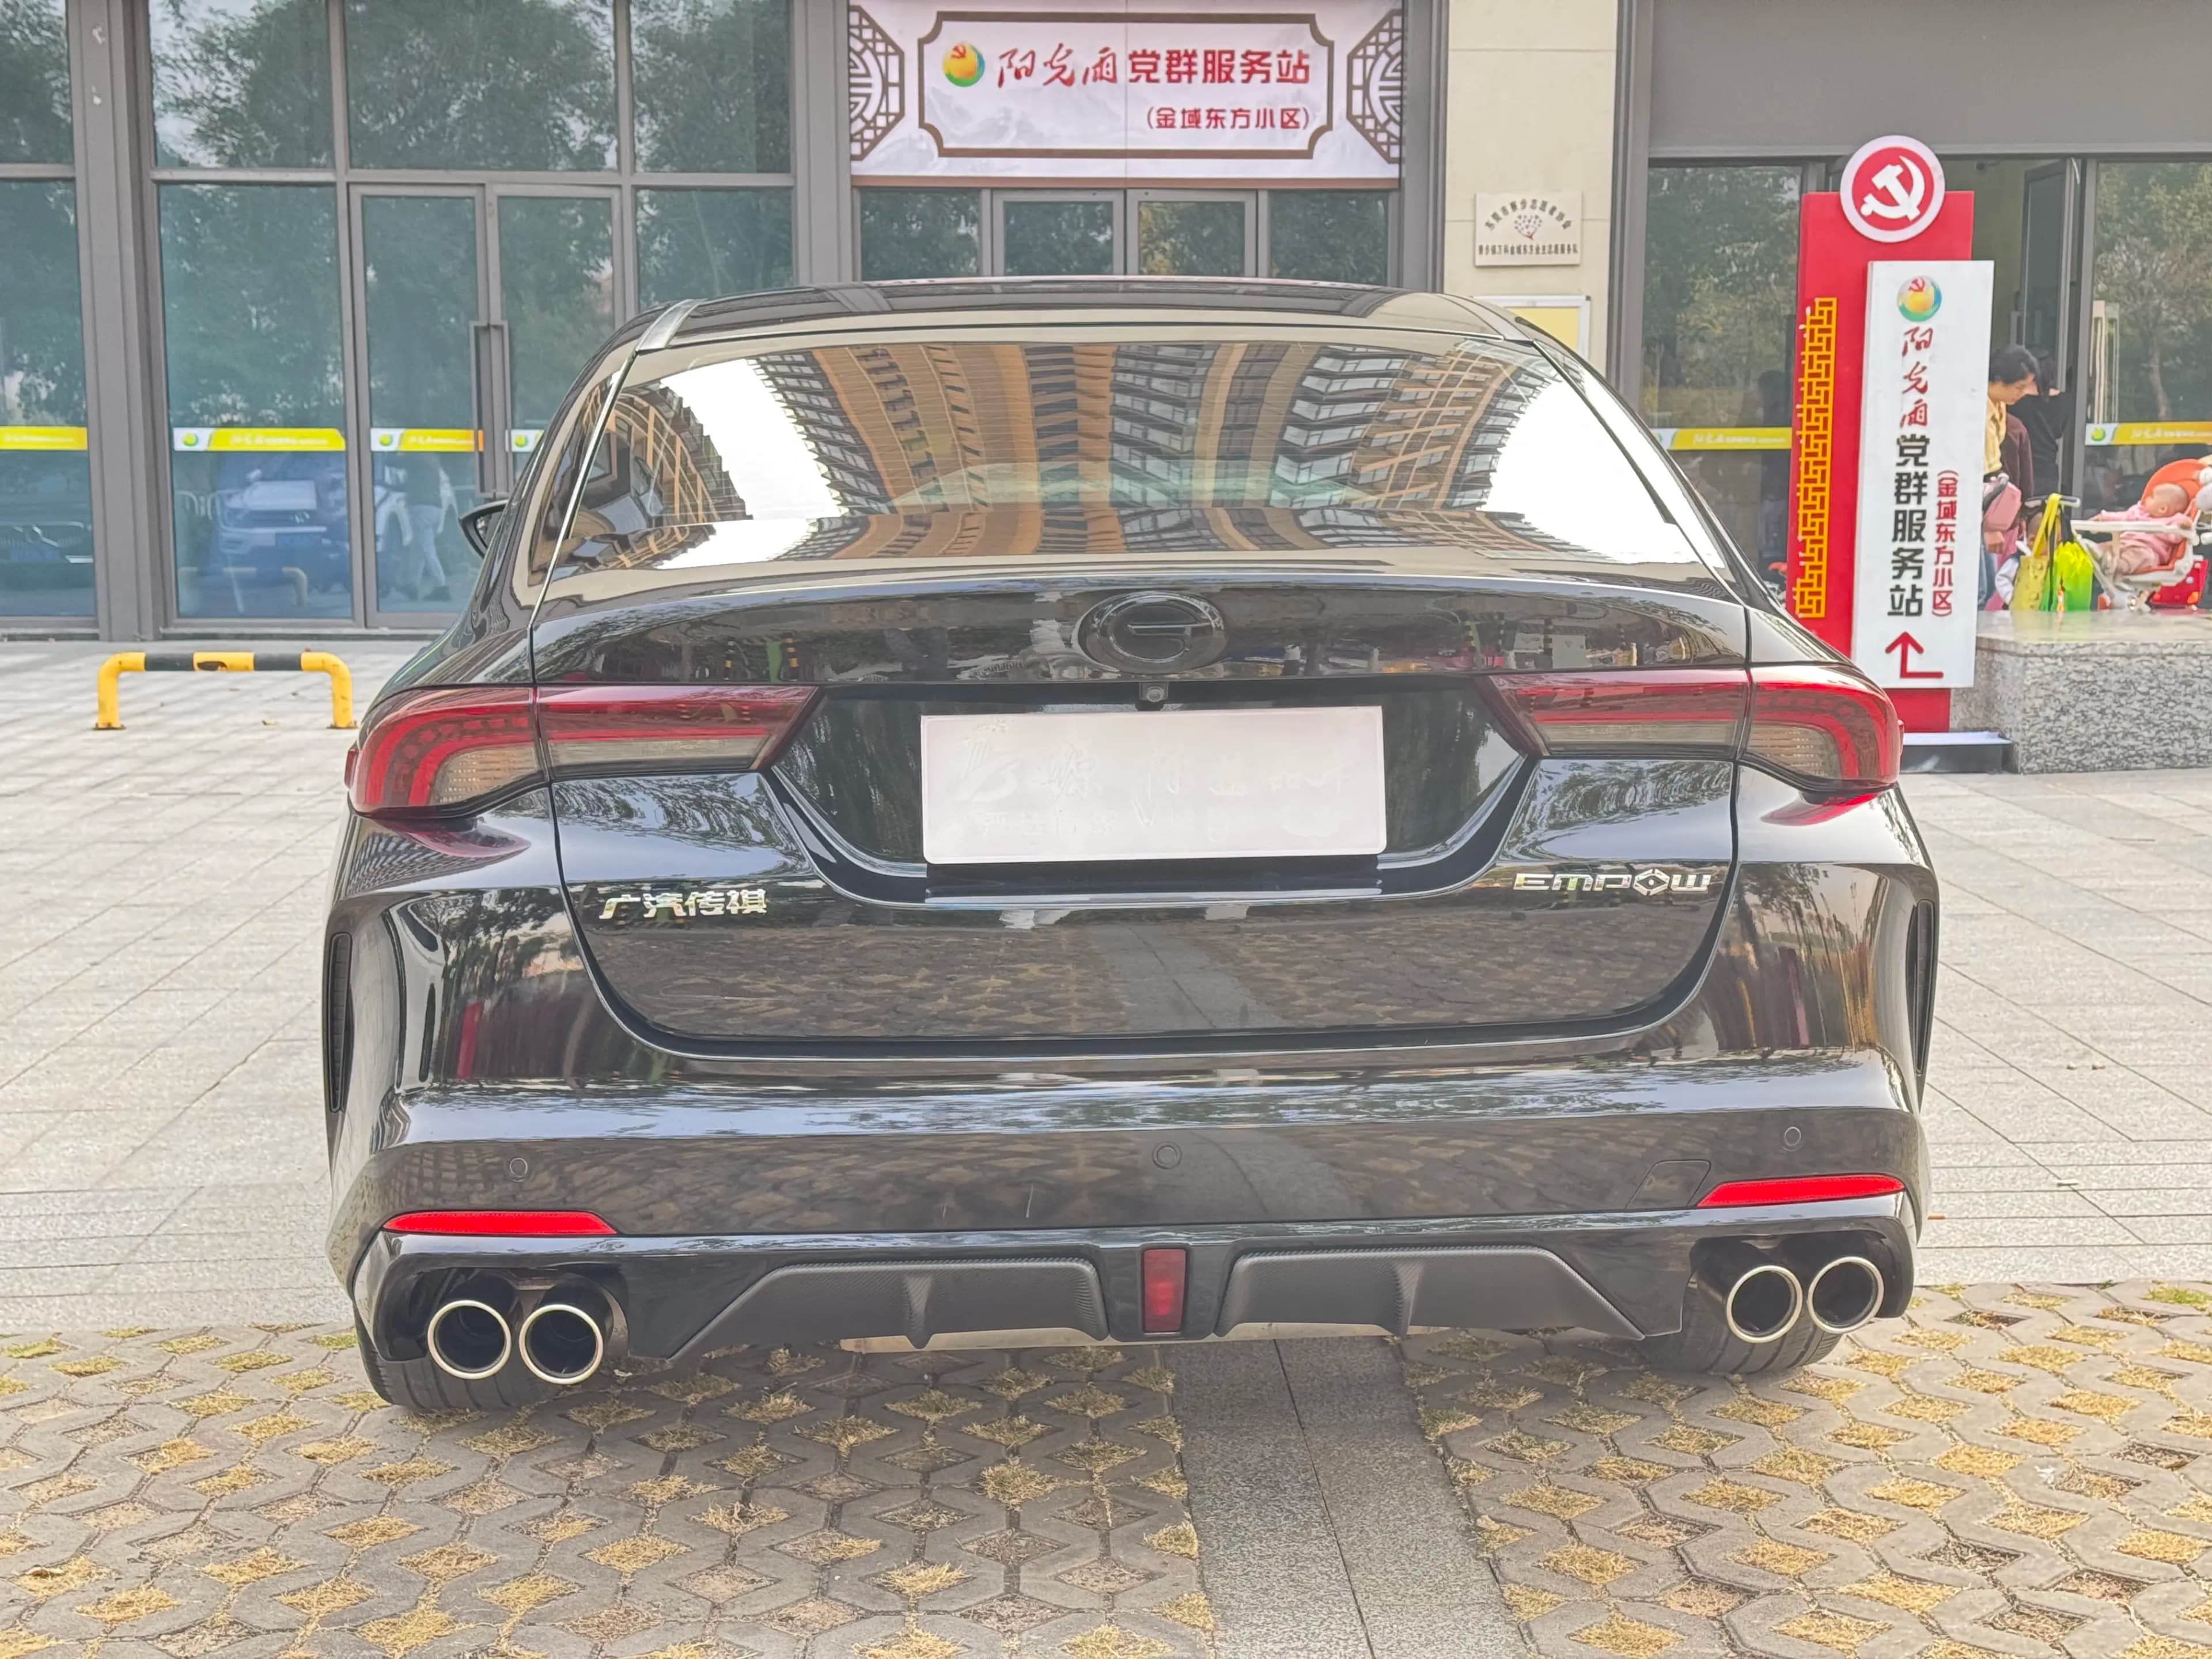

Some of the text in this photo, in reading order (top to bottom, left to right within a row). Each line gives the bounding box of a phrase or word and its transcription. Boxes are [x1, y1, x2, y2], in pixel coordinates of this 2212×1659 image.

[1513, 868, 1712, 896] EMPOW
[599, 888, 767, 920] 广汽传祺
